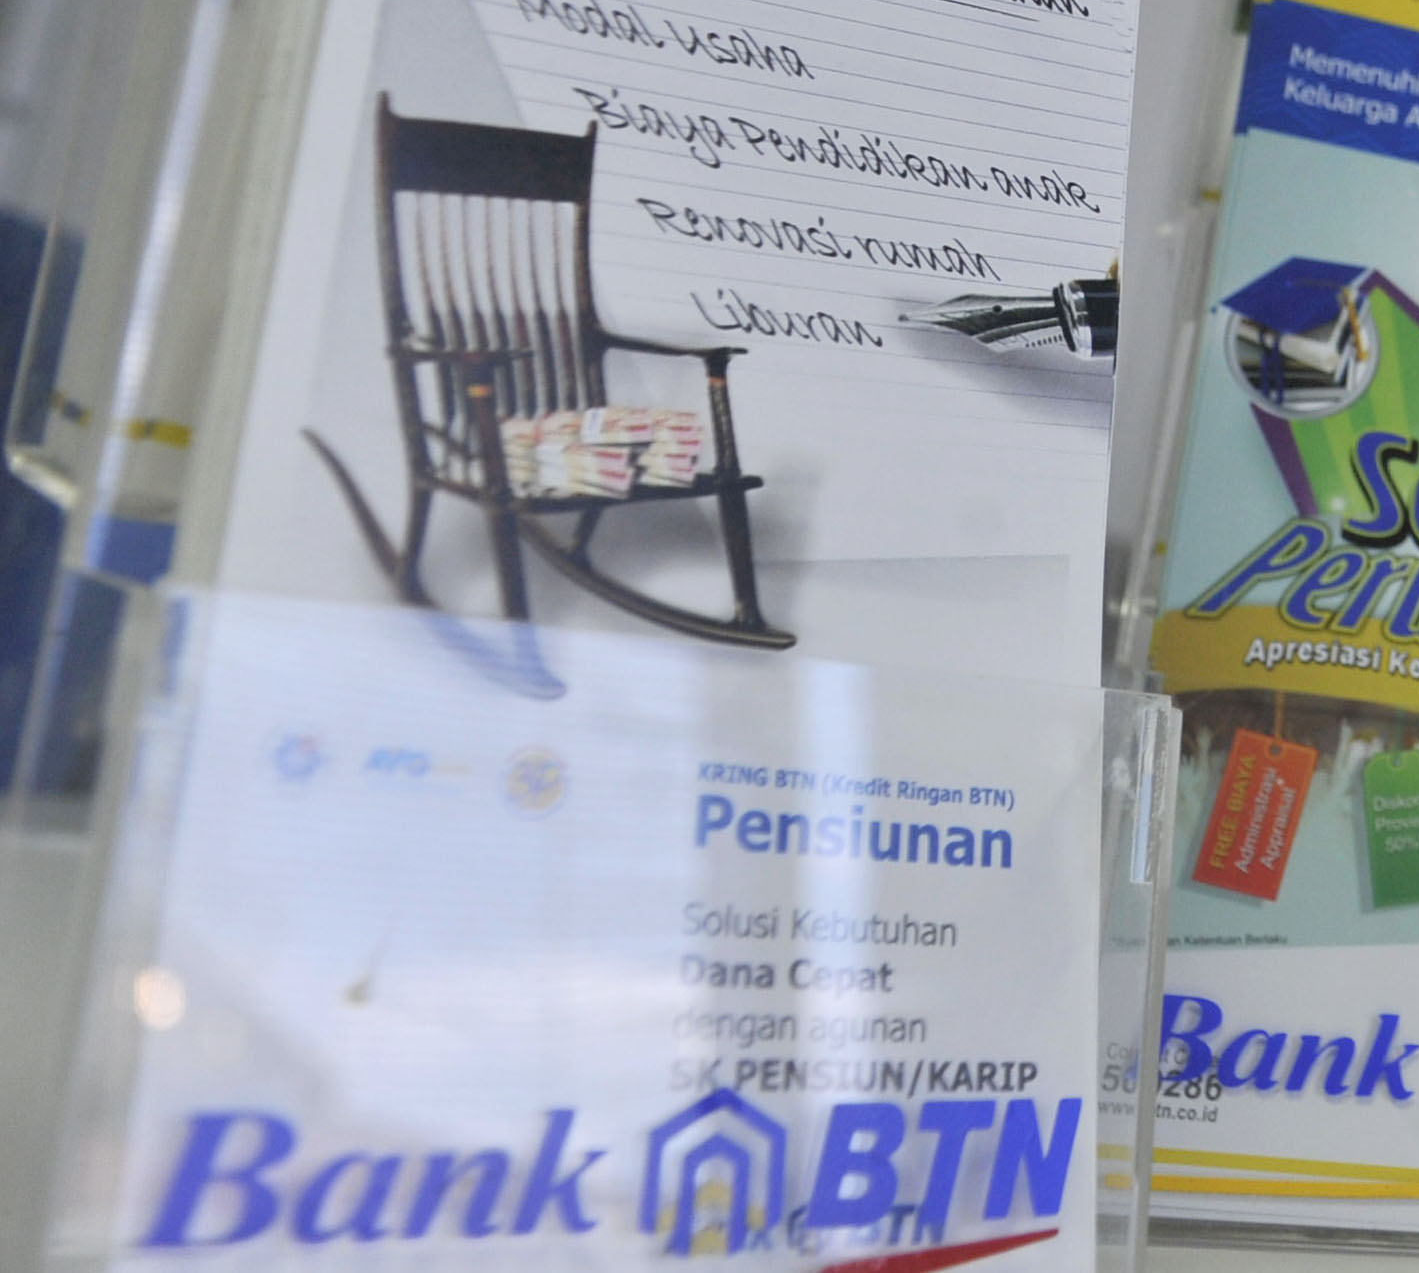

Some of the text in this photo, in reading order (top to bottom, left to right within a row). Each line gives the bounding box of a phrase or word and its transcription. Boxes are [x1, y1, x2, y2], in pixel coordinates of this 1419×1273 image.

[1282, 75, 1399, 127] Keluarga
[573, 86, 1101, 214] Biaya Pendidikan anak
[636, 197, 853, 260] Renovasi
[691, 289, 884, 348] Liburan
[1244, 637, 1381, 672] Apresiasi
[698, 762, 769, 788] KRING
[774, 768, 816, 792] BTN
[897, 780, 964, 808] Ringan
[968, 786, 1017, 812] BTN)
[693, 792, 1014, 870] Pensiunan
[1208, 816, 1240, 870] FREE
[680, 901, 959, 948] Solusi Kebutuhan
[678, 954, 894, 999] Dana Cepat
[670, 1010, 927, 1049] dengan agunan
[666, 1057, 1039, 1100] SK PENSIUN/KARIP
[1100, 1064, 1223, 1102] 50286
[130, 1106, 610, 1252] Bank
[806, 1098, 1083, 1232] BTN
